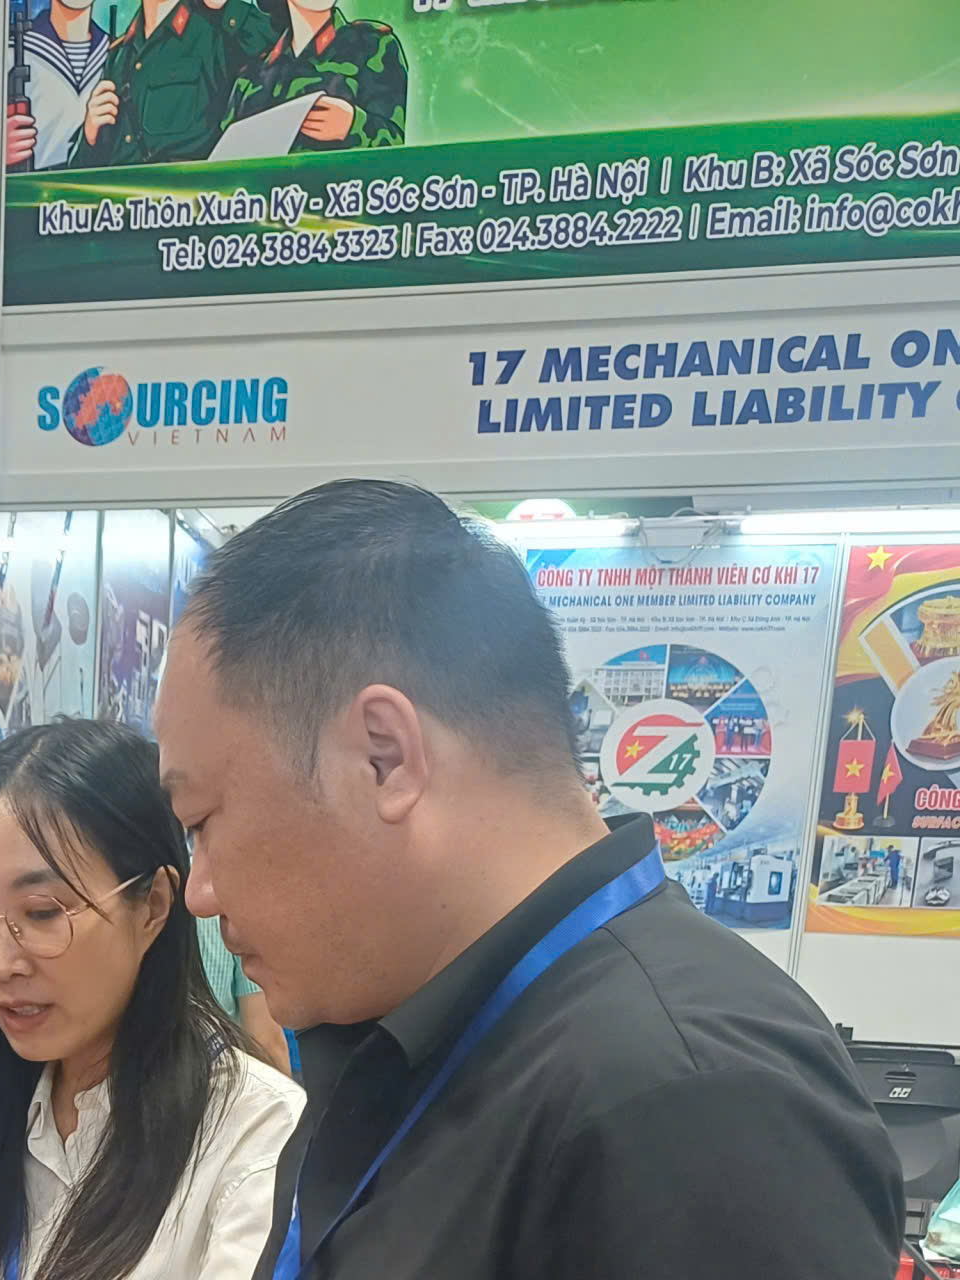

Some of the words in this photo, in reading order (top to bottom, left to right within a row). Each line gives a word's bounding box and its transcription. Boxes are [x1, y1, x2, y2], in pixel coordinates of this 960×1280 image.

[41, 202, 90, 235] Khu
[94, 203, 123, 231] A:
[128, 196, 191, 230] Thôn
[197, 191, 264, 225] Xuân
[271, 187, 305, 226] Kỳ
[325, 181, 360, 217] Xã
[368, 177, 417, 214] Sóc
[423, 175, 475, 209] Sơn
[501, 171, 546, 204] TP.
[551, 167, 589, 202] Hà
[597, 159, 648, 205] Nội
[683, 155, 744, 193] Khu
[752, 152, 785, 187] B:
[787, 145, 830, 185] Xã
[834, 143, 893, 181] Sóc
[897, 142, 960, 176] Sơn
[159, 240, 205, 271] Tel:
[208, 235, 257, 268] 024
[260, 230, 329, 264] 3884
[336, 227, 395, 260] 3323
[415, 223, 474, 257] Fax:
[476, 207, 682, 252] 024.3884.2222
[706, 196, 800, 237] Email:
[469, 350, 526, 386] 17
[539, 333, 870, 384] MECHANICAL
[477, 392, 673, 434] LIMITED
[691, 381, 941, 427] LIABILITY
[128, 426, 288, 446] VIETNAM
[577, 568, 593, 587] TY
[596, 567, 631, 586] TNHH
[803, 566, 820, 584] 17
[615, 595, 634, 607] ONE
[678, 594, 715, 606] LIMITED
[718, 593, 763, 606] LIABILITY
[765, 593, 817, 606] COMPANY
